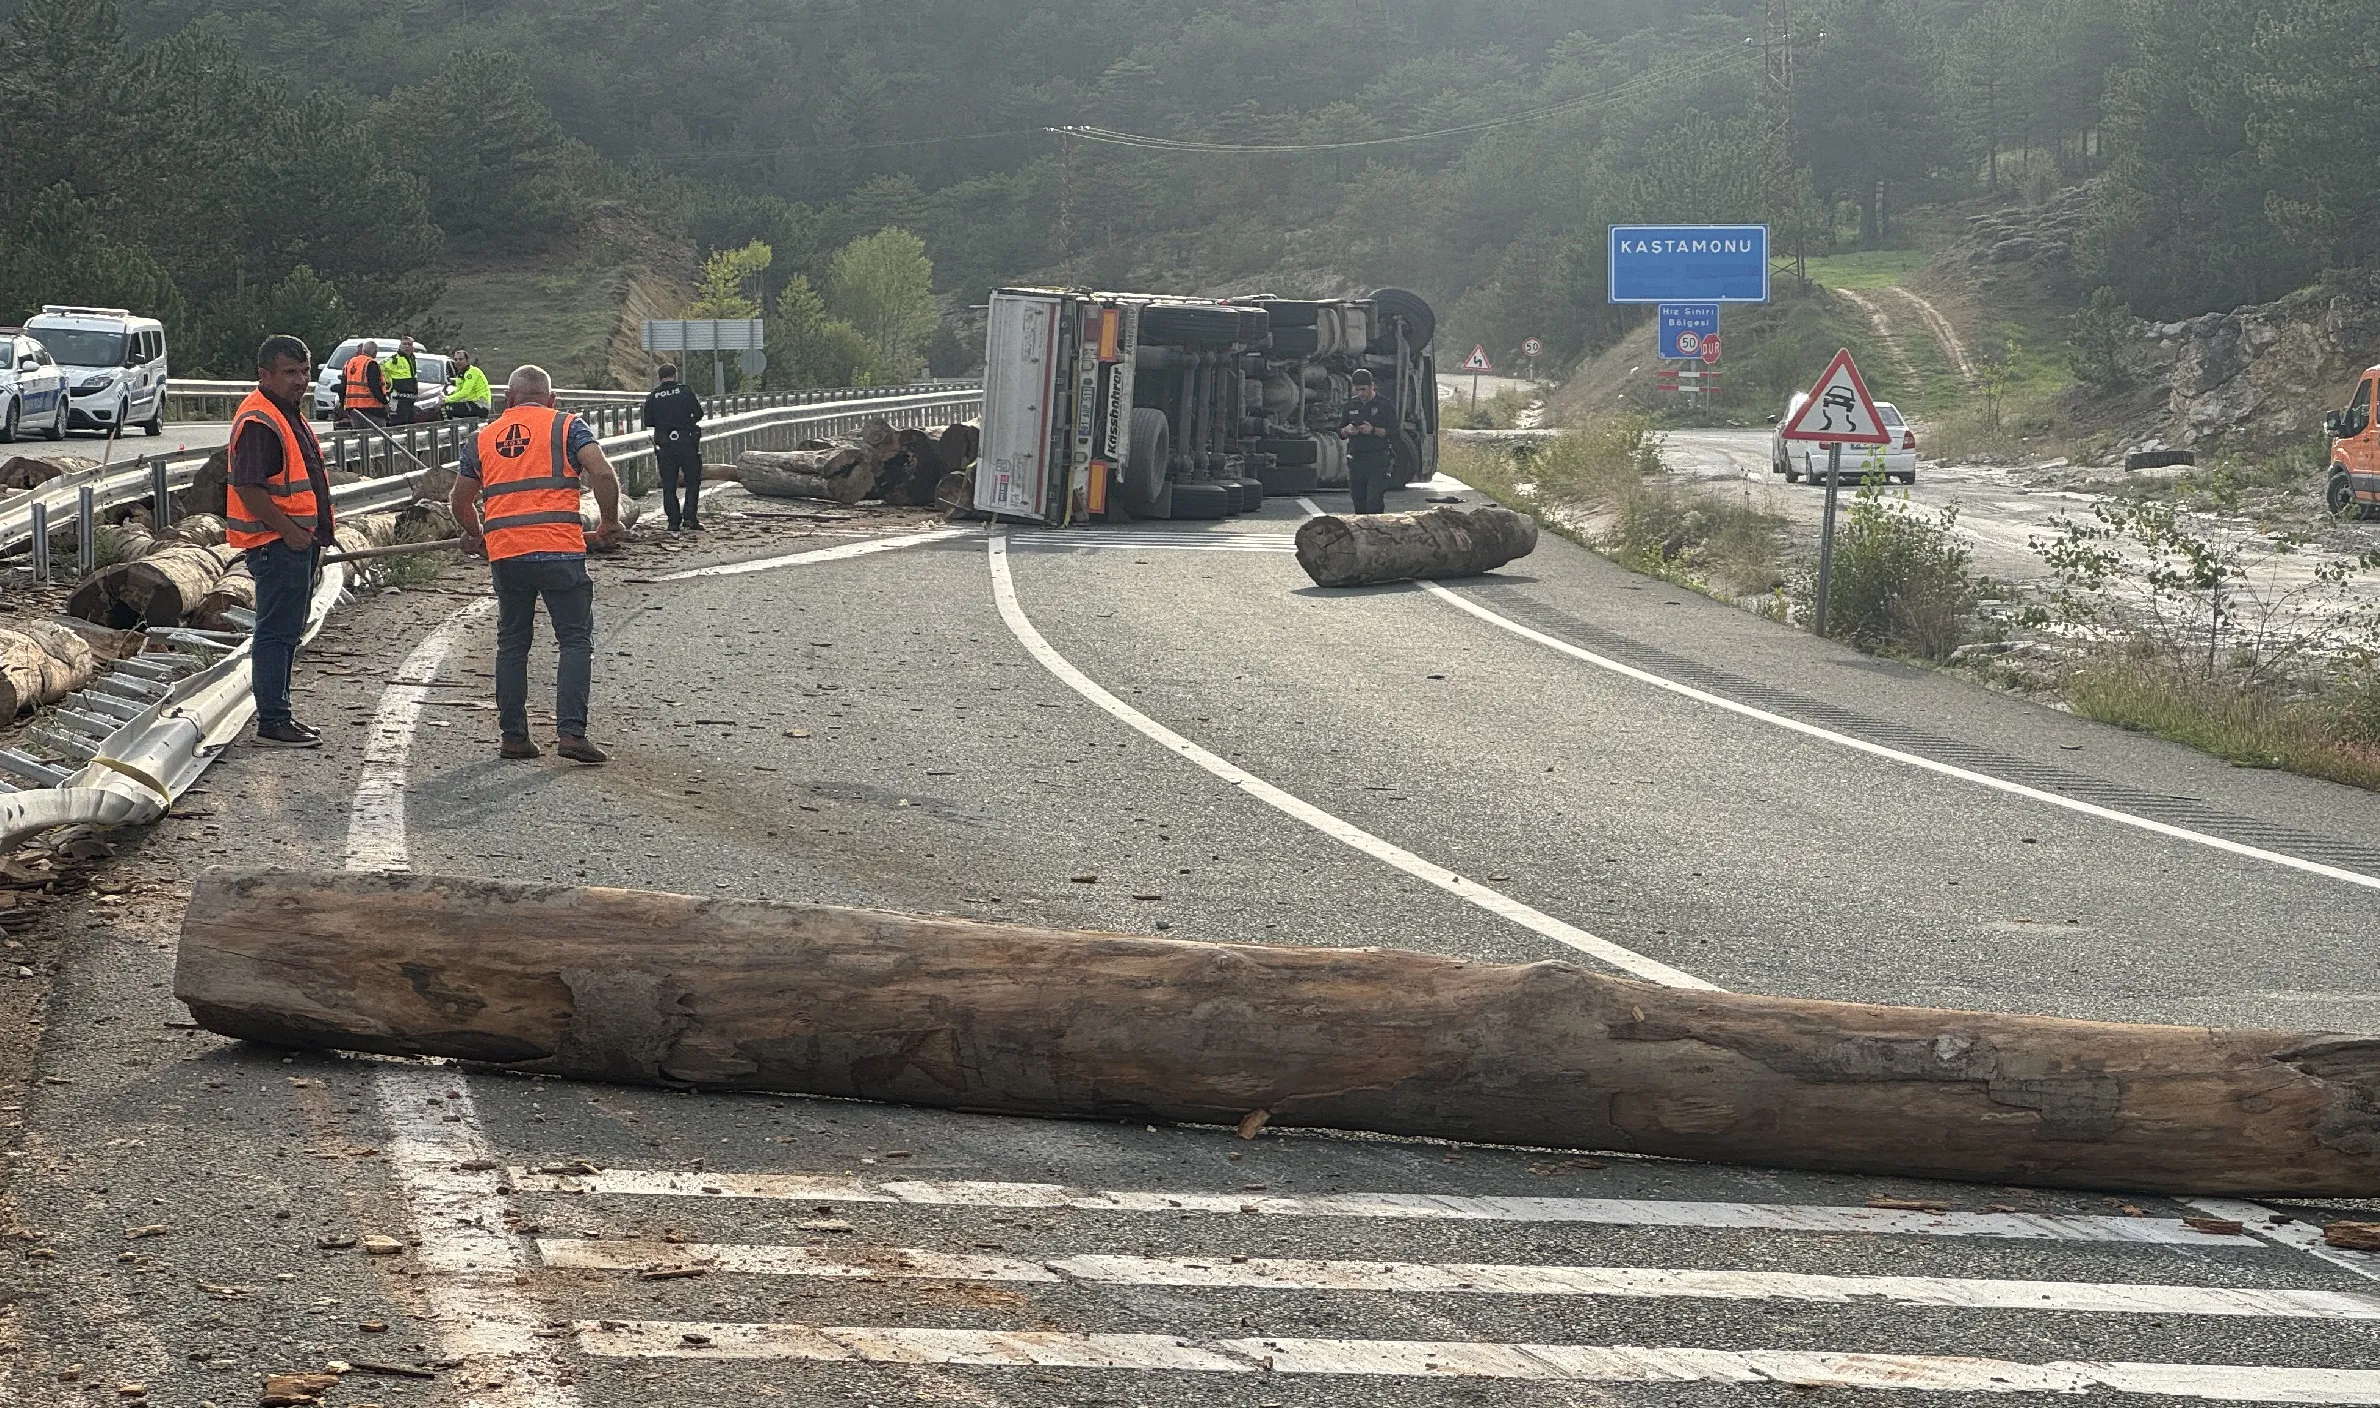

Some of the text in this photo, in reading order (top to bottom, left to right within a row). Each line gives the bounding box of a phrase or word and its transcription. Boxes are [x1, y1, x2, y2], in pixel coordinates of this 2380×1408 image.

[1621, 240, 1752, 254] KASTAMONU
[1668, 318, 1710, 327] Bölgesi
[1526, 342, 1538, 351] 50
[1682, 337, 1697, 348] 50
[1702, 341, 1720, 355] DUR
